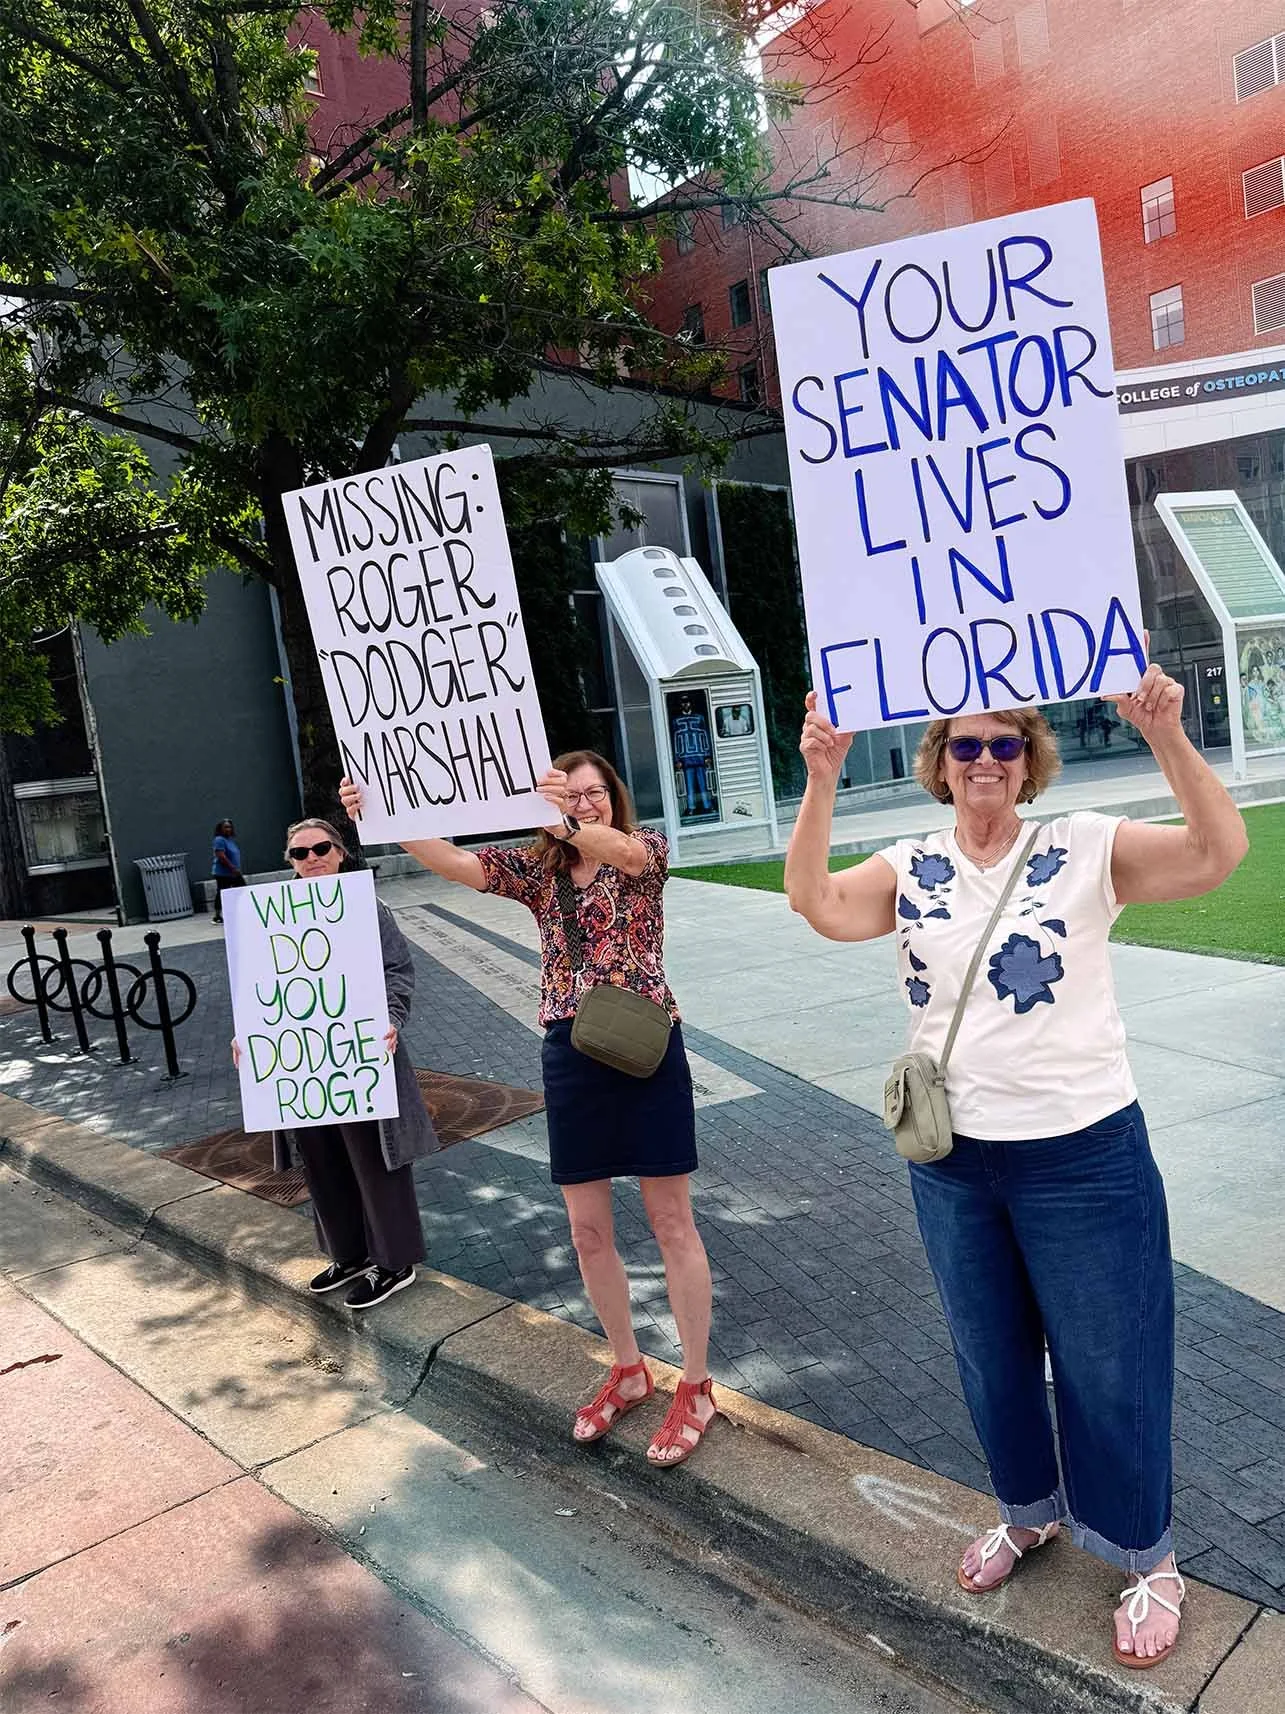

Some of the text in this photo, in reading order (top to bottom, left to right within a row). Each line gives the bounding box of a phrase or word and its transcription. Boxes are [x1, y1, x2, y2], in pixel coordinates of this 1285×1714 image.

[819, 235, 1073, 358] YOUR
[793, 326, 1114, 463] SENATOR
[1185, 382, 1200, 397] of
[299, 463, 484, 562] MISSING:
[855, 423, 1072, 556] LIVES
[326, 539, 496, 636] ROGER
[911, 536, 1014, 624] IN
[319, 612, 526, 727] "DODGER"
[820, 597, 1149, 728] FLORIDA
[1206, 667, 1223, 677] 217
[340, 708, 537, 821] MARSHALL
[250, 880, 345, 928] WHY
[270, 928, 331, 975] DO
[255, 974, 347, 1026] YOU
[248, 1018, 390, 1083] DODGE,
[276, 1066, 380, 1122] ROG?
